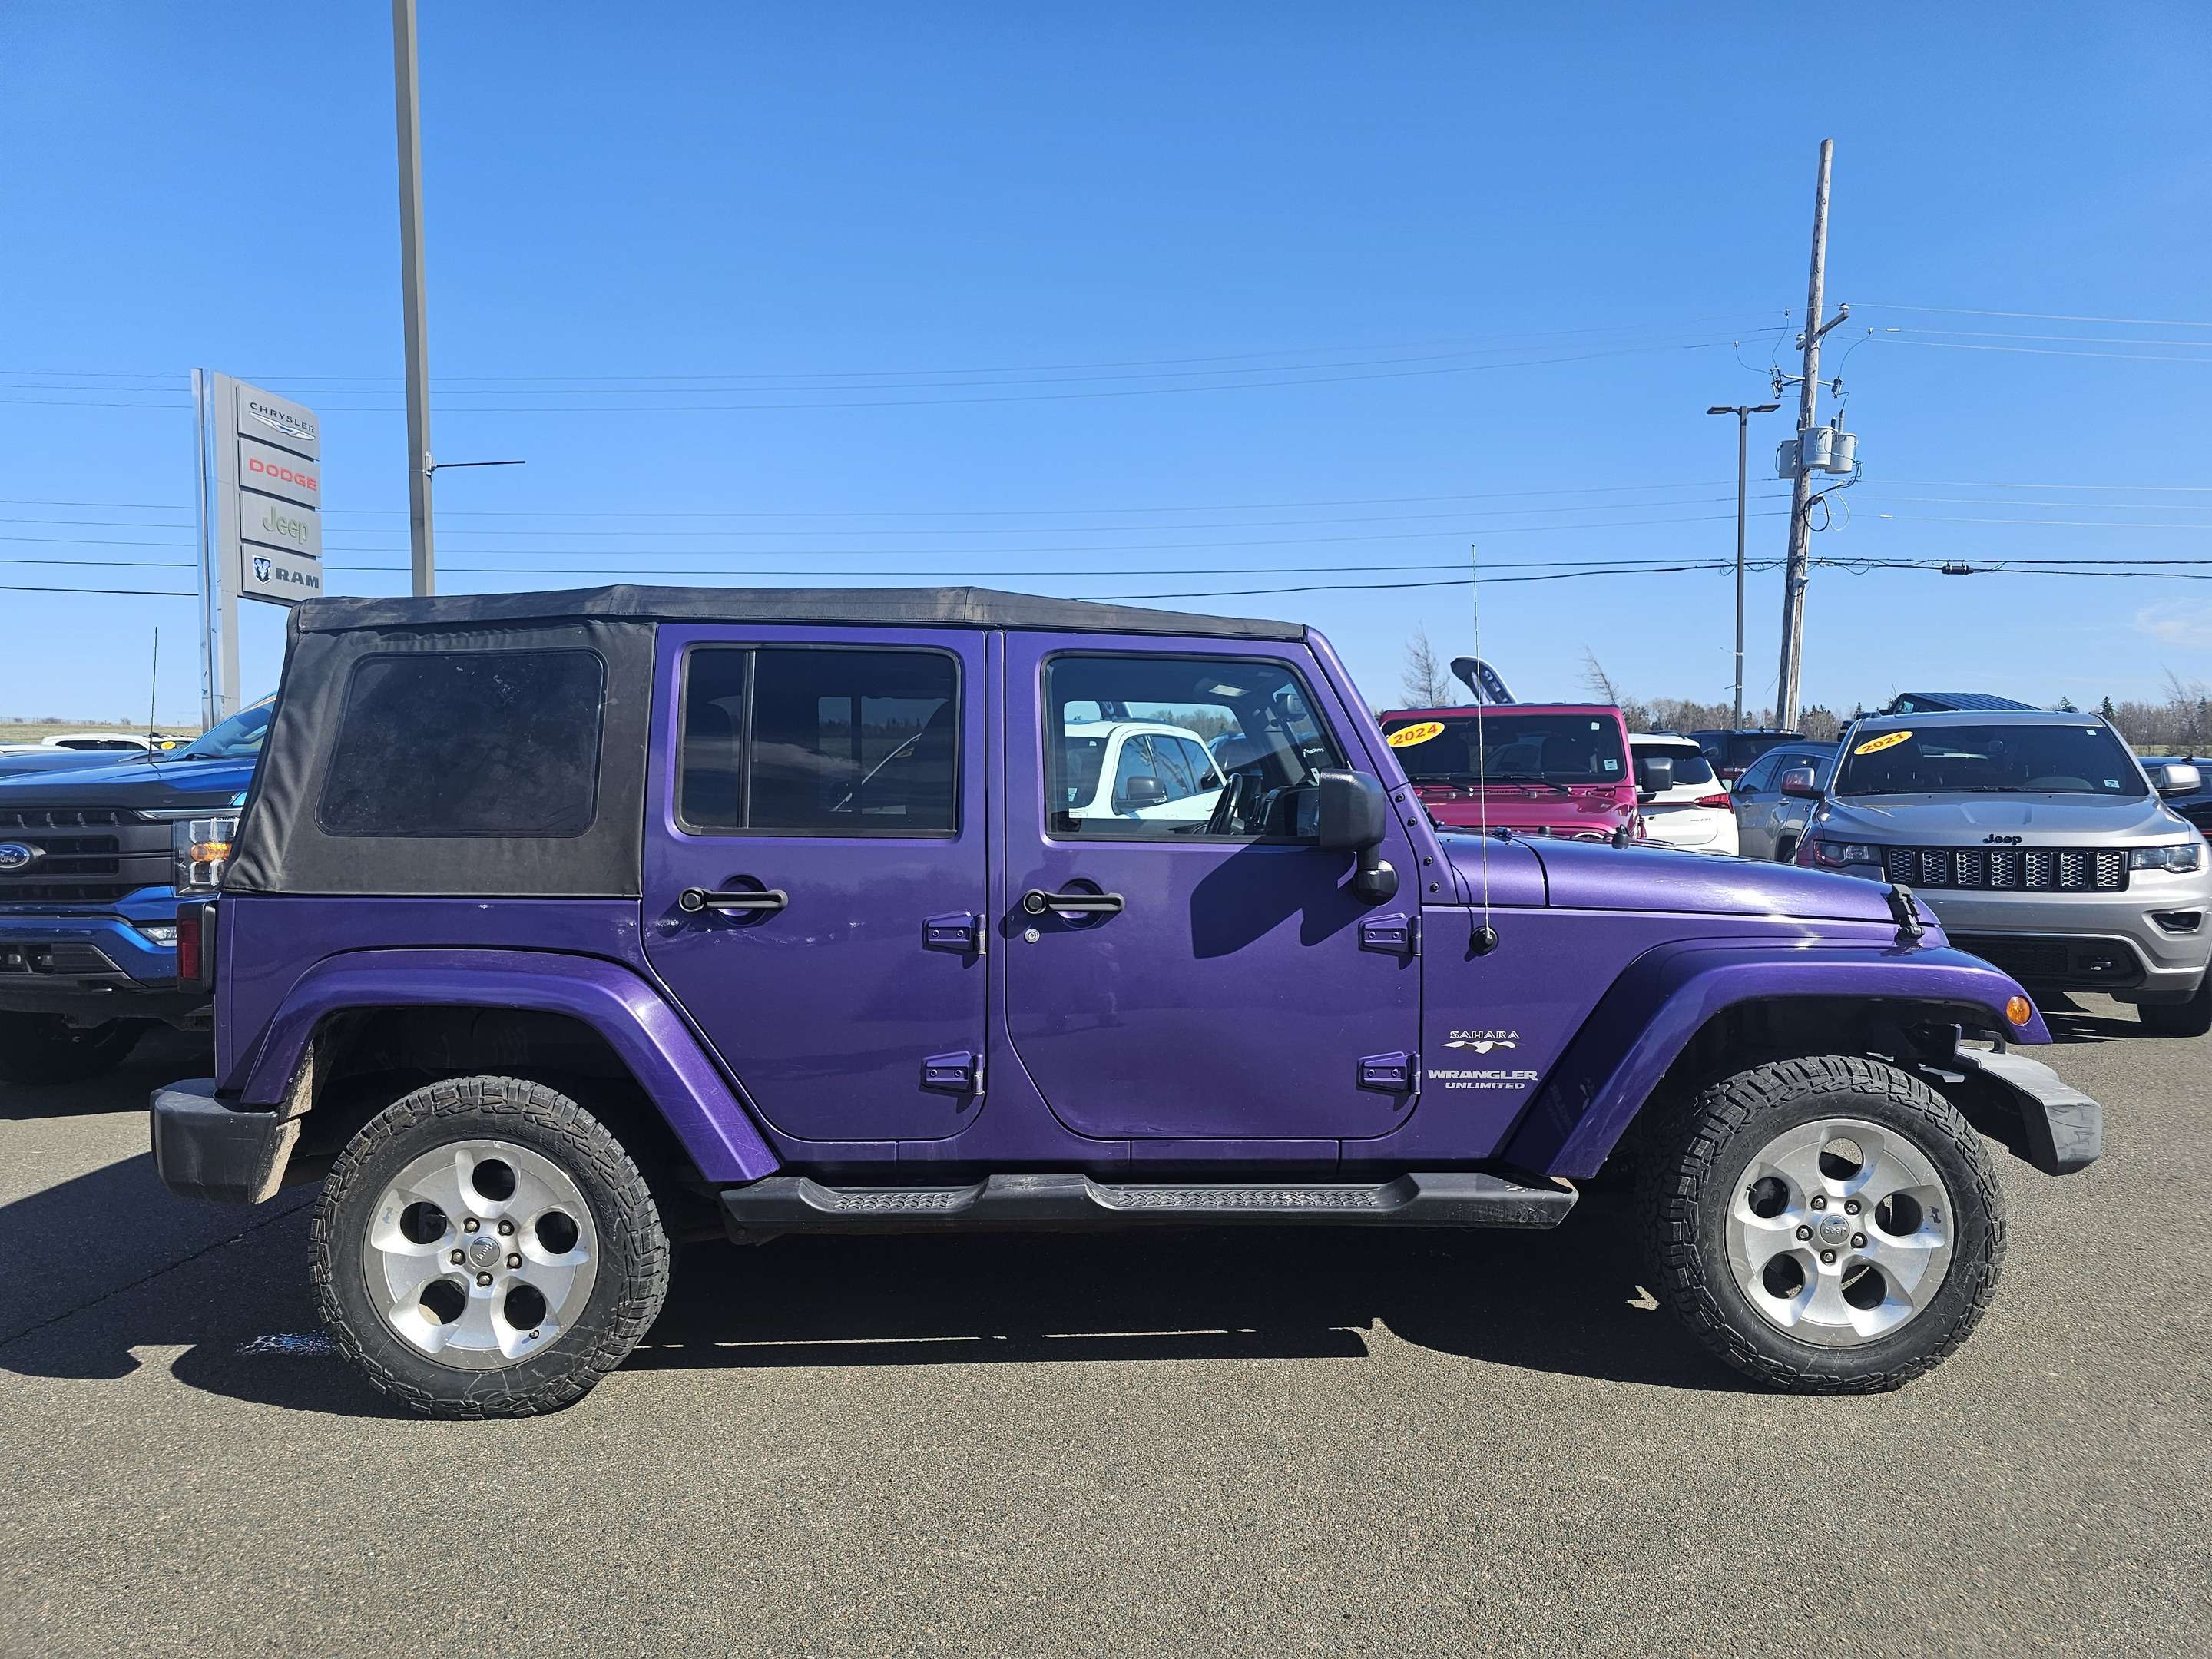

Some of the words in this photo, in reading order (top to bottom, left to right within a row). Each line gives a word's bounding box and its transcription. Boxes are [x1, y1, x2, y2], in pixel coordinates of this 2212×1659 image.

[250, 402, 315, 433] CHRYSLER
[249, 458, 317, 492] DODGE
[262, 505, 308, 545] Jeep
[276, 567, 320, 589] RAM
[1394, 724, 1438, 745] 2024
[1862, 733, 1904, 753] 2021
[1982, 833, 2022, 846] Jeep
[1449, 1030, 1521, 1039] SAHARA
[1427, 1069, 1539, 1081] WRANGLER
